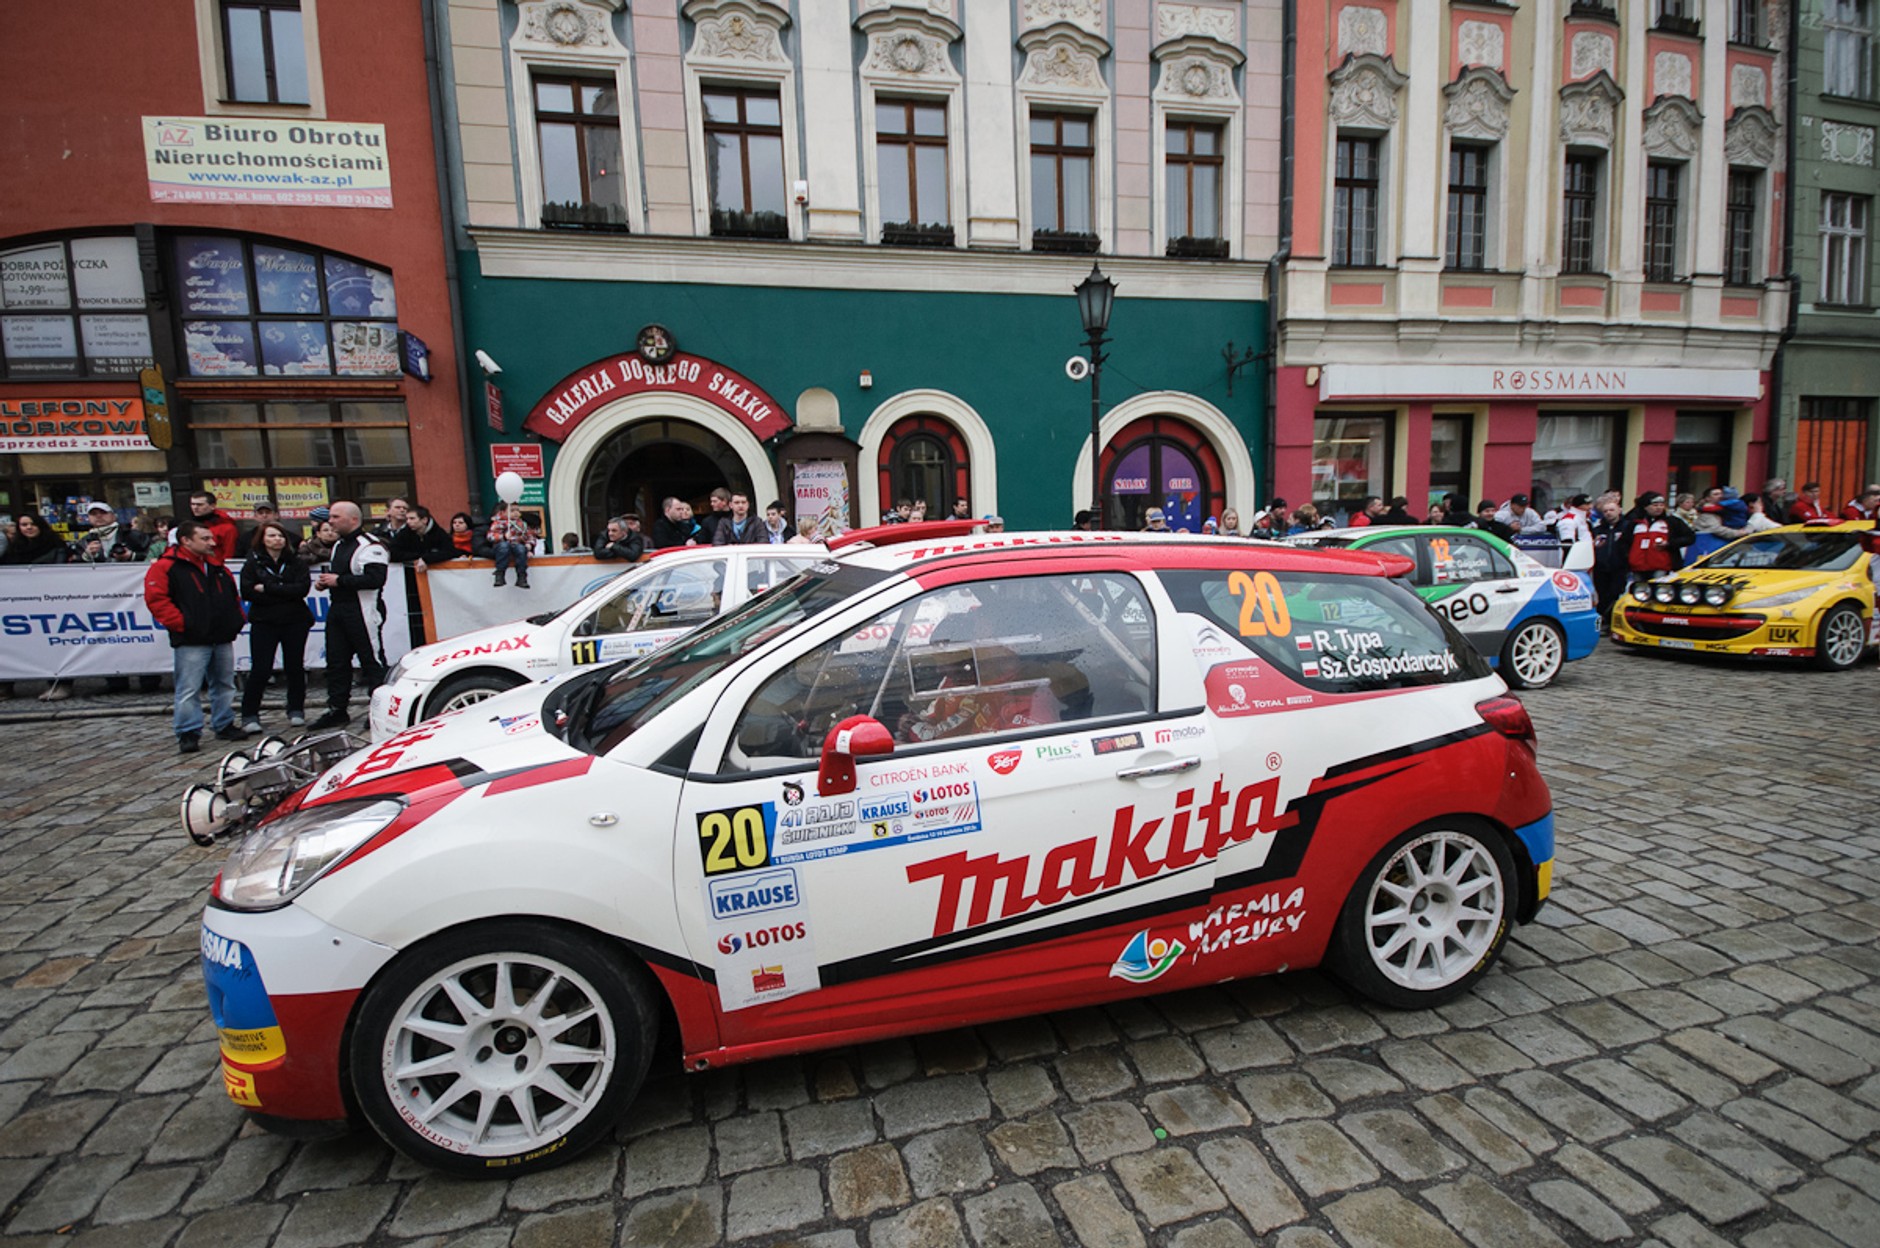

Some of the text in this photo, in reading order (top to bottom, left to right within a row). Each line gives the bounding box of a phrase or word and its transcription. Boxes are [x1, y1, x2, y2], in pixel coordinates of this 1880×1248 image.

[162, 129, 189, 143] AZ
[204, 125, 380, 147] Biuro Obrotu
[155, 150, 383, 170] Nieruchomościami
[189, 172, 352, 187] www.nowak-az.pl
[1, 261, 40, 271] DOBRA
[1493, 370, 1626, 390] ROSSMANN
[545, 369, 616, 426] GALERIA
[618, 359, 701, 386] DOBREGO
[708, 371, 773, 424] SMAKU
[1430, 538, 1453, 561] 12
[1228, 571, 1292, 637] 20
[1323, 602, 1341, 621] 12
[49, 634, 155, 646] Professional
[432, 634, 532, 667] SONAX
[1314, 629, 1383, 654] R. Typa
[572, 641, 597, 664] 11
[1347, 649, 1459, 680] Gospodarczyk
[1252, 699, 1284, 708] TOTAL
[1036, 743, 1071, 759] Plus
[870, 762, 969, 787] CITROËN BANK
[930, 782, 970, 800] LOTOS
[780, 810, 802, 828] 41
[861, 801, 909, 820] KRAUSE
[925, 806, 949, 818] LOTOS
[700, 808, 768, 873] 20
[906, 773, 1300, 938] makita
[716, 884, 795, 916] KRAUSE
[1189, 887, 1304, 942] WARMIA
[745, 922, 806, 950] LOTOS
